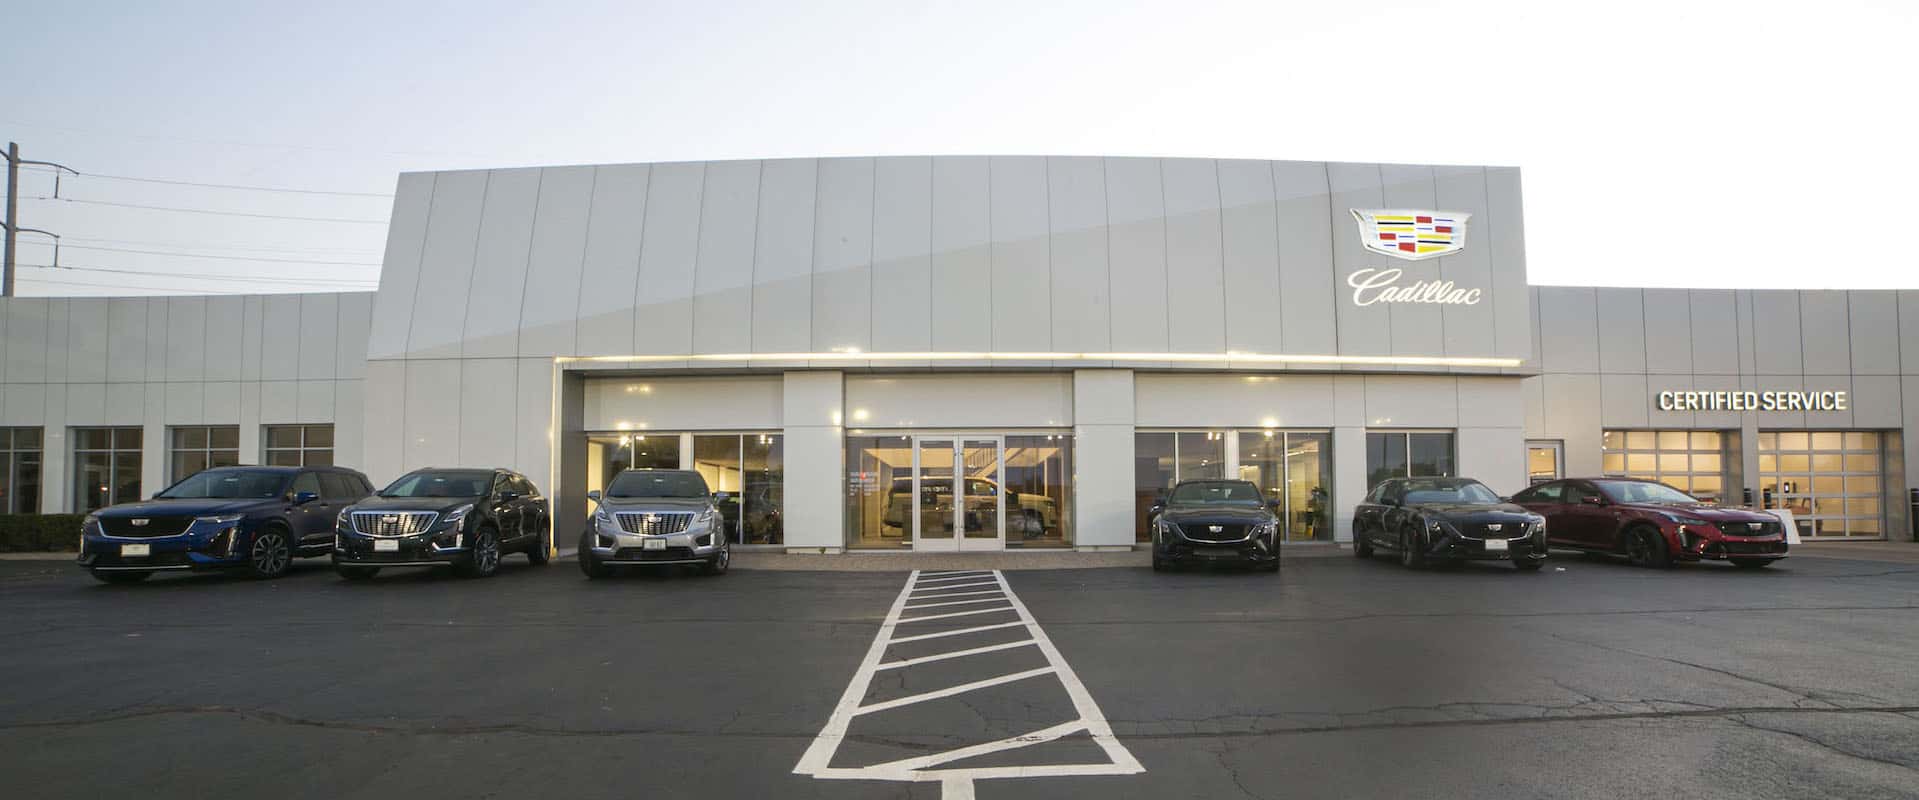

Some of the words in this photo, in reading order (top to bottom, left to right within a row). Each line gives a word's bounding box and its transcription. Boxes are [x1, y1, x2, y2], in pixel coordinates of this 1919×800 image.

[1347, 268, 1481, 306] Cadillac
[1659, 391, 1758, 410] CERTIFIED
[1762, 391, 1847, 410] SERVICE
